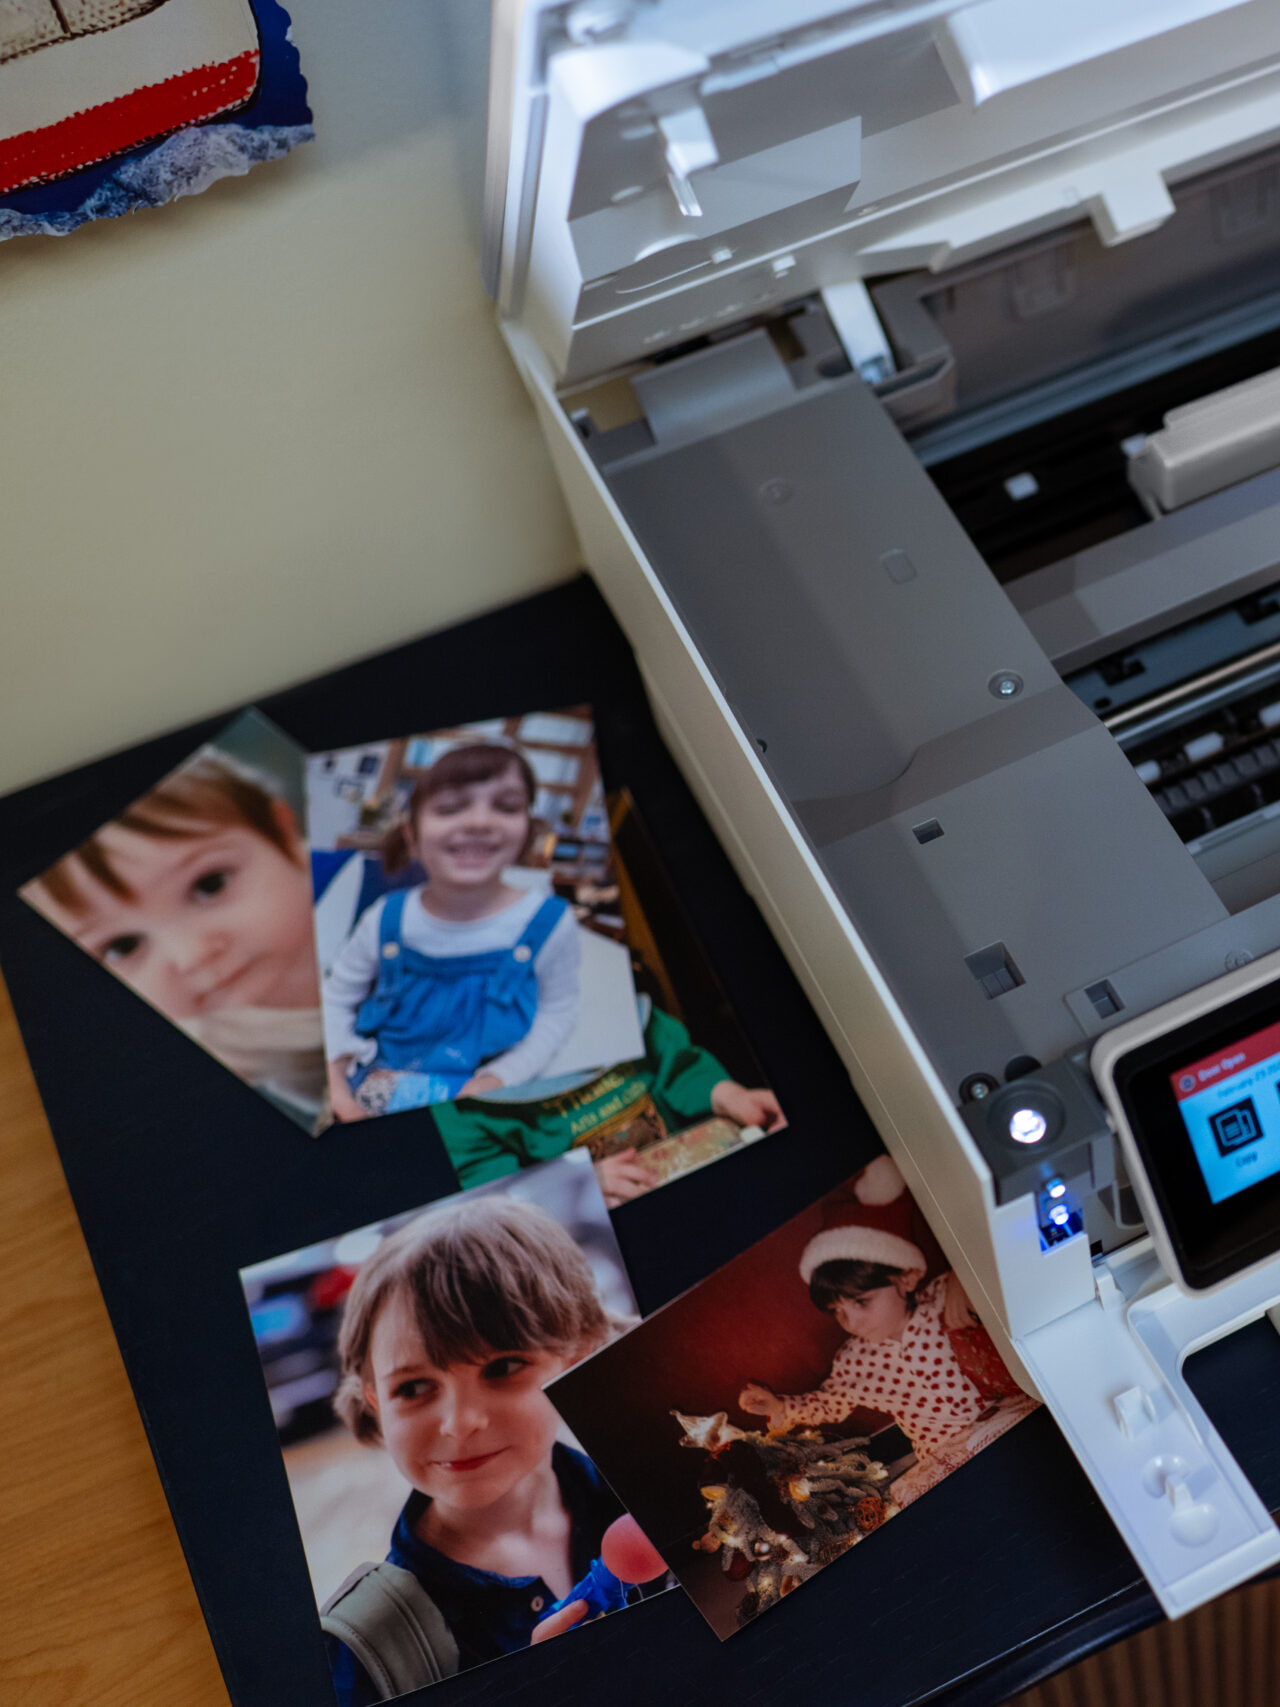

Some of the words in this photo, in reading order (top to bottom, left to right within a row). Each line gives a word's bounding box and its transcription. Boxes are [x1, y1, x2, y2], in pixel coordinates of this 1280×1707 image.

[1198, 1065, 1221, 1082] Door
[1221, 1053, 1246, 1071] Open
[1235, 1151, 1258, 1169] Copy
